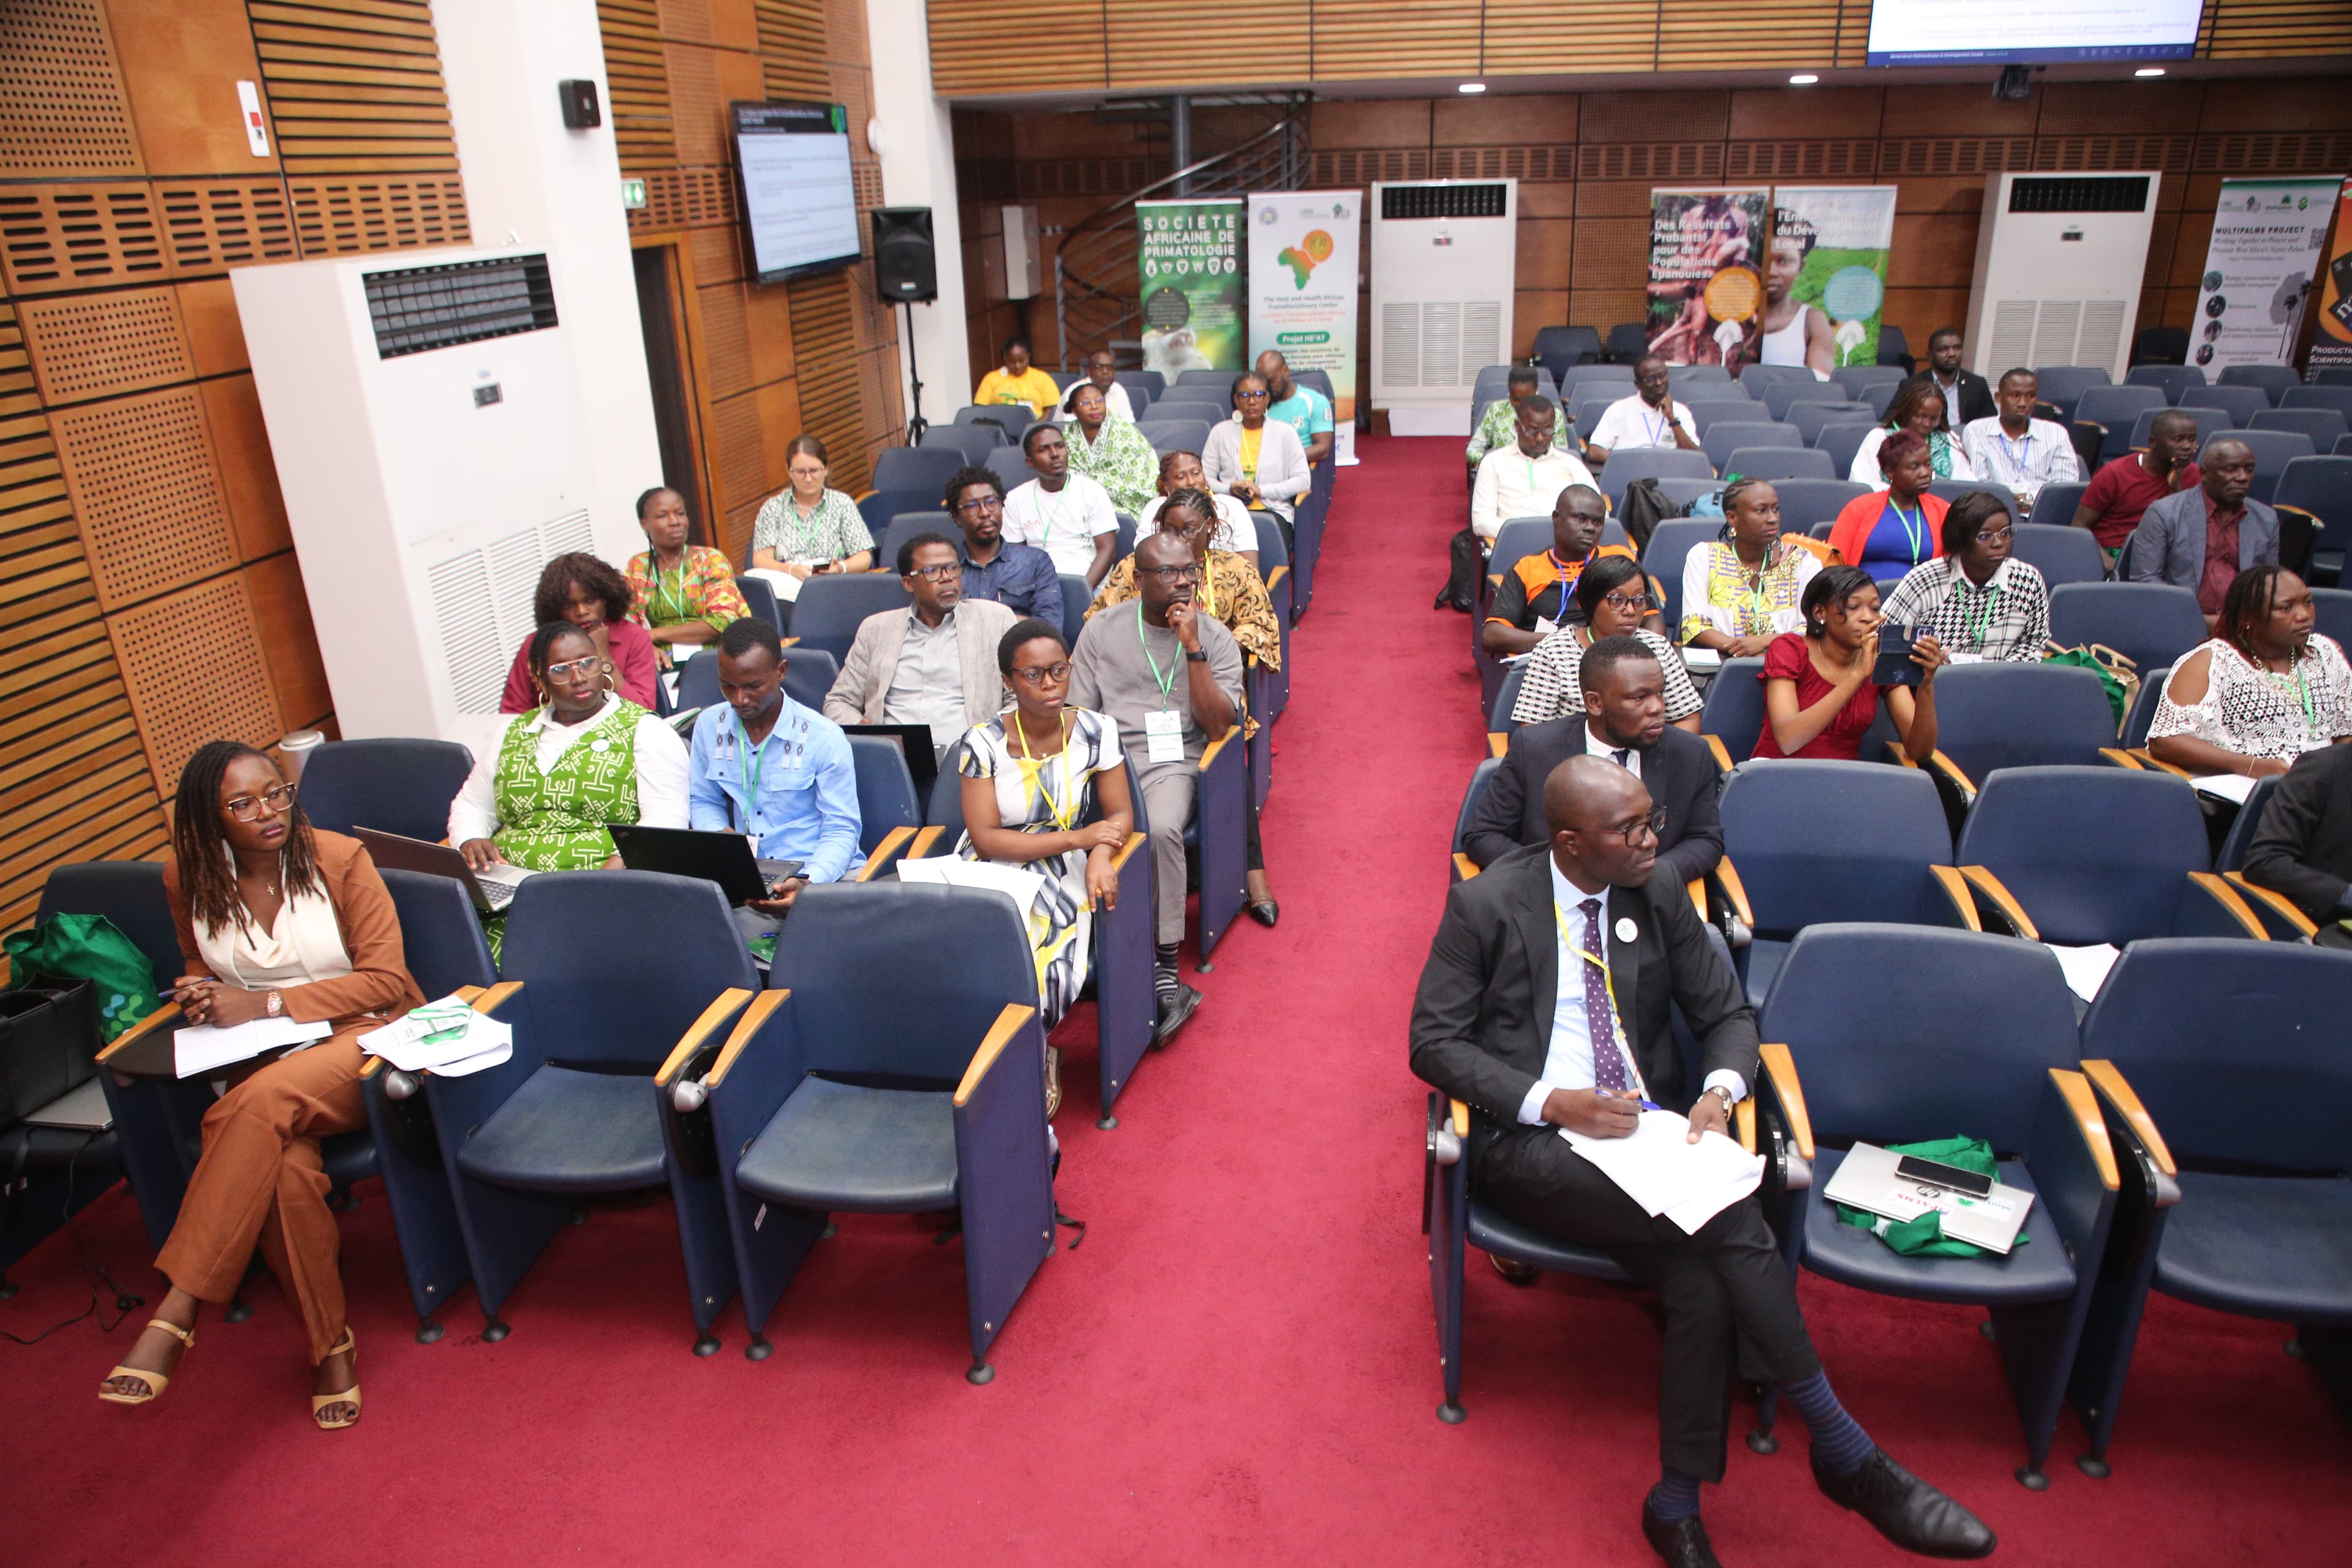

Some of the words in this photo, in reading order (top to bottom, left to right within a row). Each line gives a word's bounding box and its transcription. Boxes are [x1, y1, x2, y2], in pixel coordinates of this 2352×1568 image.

[1654, 220, 1675, 230] Des
[1777, 224, 1791, 235] du
[2268, 225, 2305, 234] PROJECT
[1144, 230, 1211, 244] AFRICAINE
[1218, 229, 1235, 243] DE
[1776, 238, 1805, 249] Local
[1144, 244, 1235, 258] PRIMATOLOGIE
[1653, 246, 1679, 255] pour
[1681, 245, 1700, 255] des
[1653, 257, 1717, 268] Populations
[2311, 345, 2352, 354] PRODUCTI
